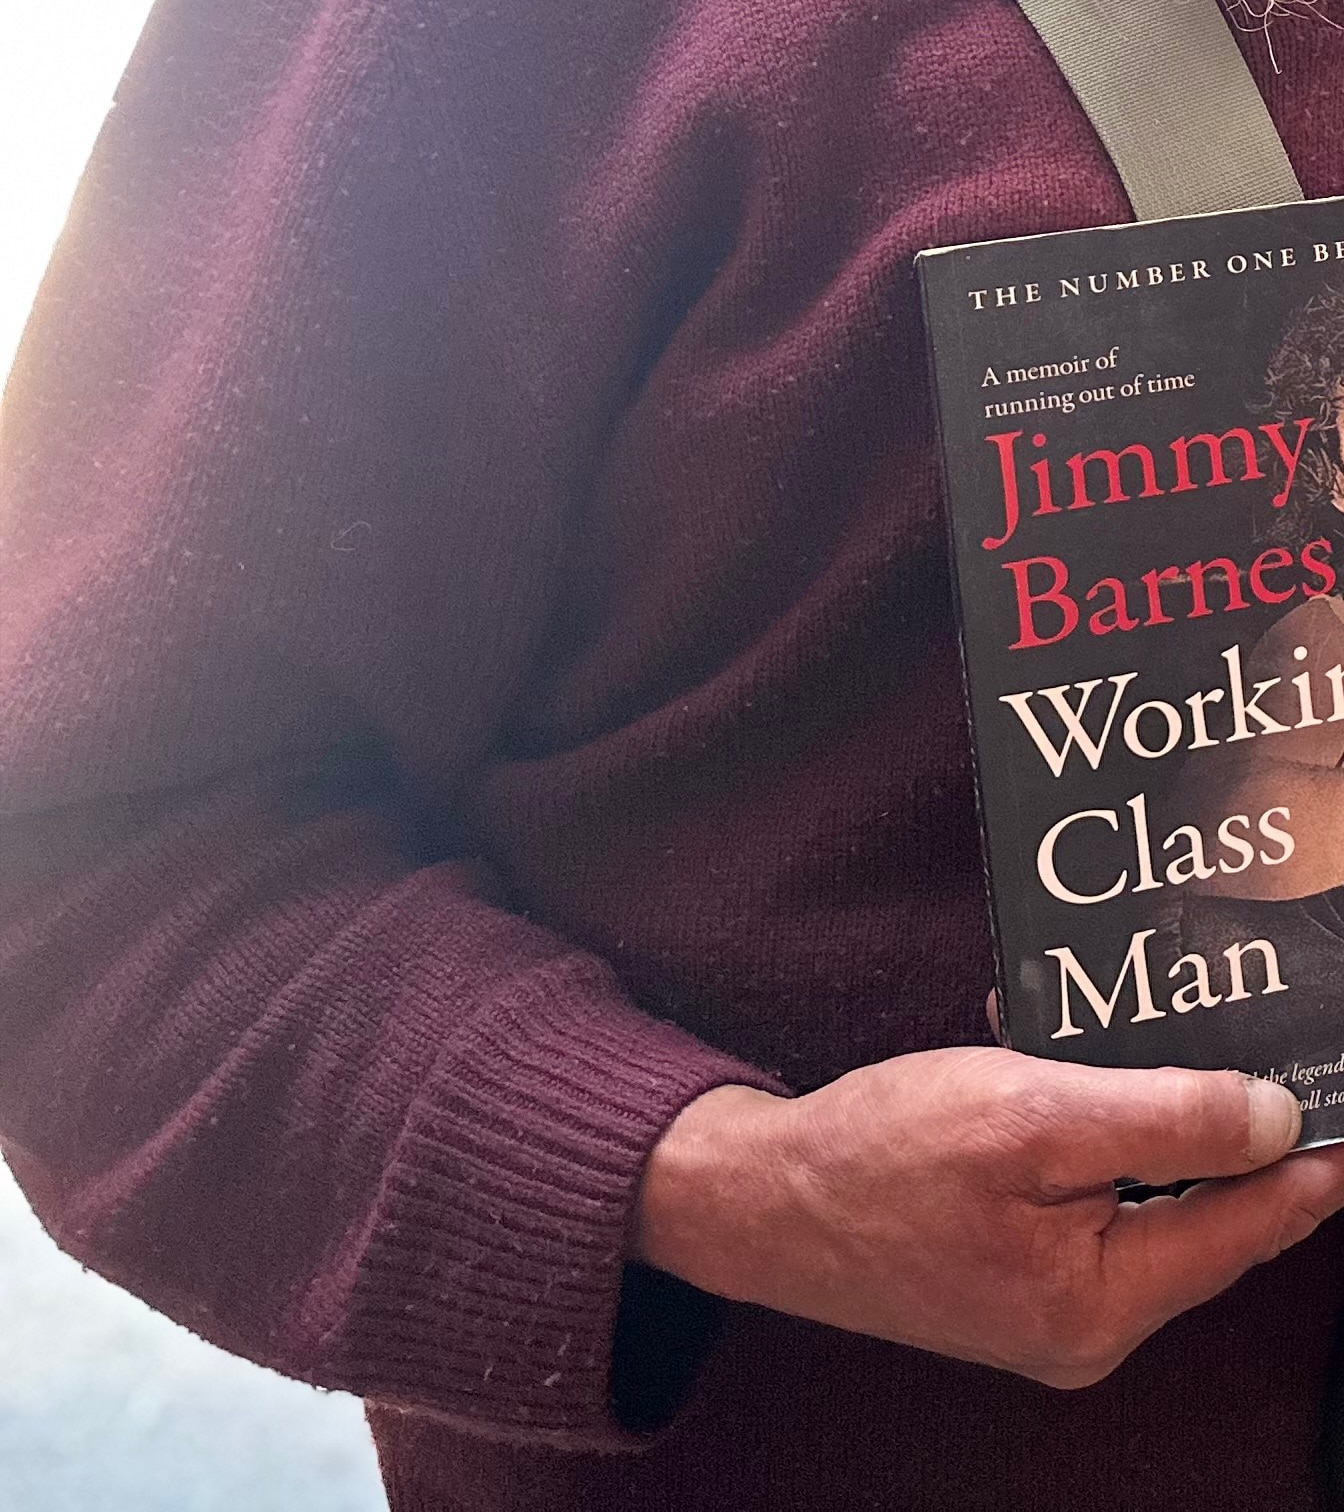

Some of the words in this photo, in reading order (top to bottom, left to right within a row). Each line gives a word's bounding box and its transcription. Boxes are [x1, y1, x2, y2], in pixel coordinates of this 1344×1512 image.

[968, 282, 1044, 312] THE
[1059, 257, 1212, 300] NUMBER
[1226, 247, 1298, 275] ONE
[981, 365, 1002, 388] A
[1004, 353, 1091, 386] memoir
[1092, 346, 1121, 371] of
[983, 388, 1076, 420] running
[1078, 381, 1116, 406] out
[1118, 372, 1145, 397] of
[1146, 369, 1196, 394] time
[982, 417, 1318, 551] Jimmy
[1002, 538, 1337, 651] Barnes
[1036, 793, 1297, 906] Class
[1044, 929, 1290, 1041] Man
[1298, 1088, 1322, 1112] oll
